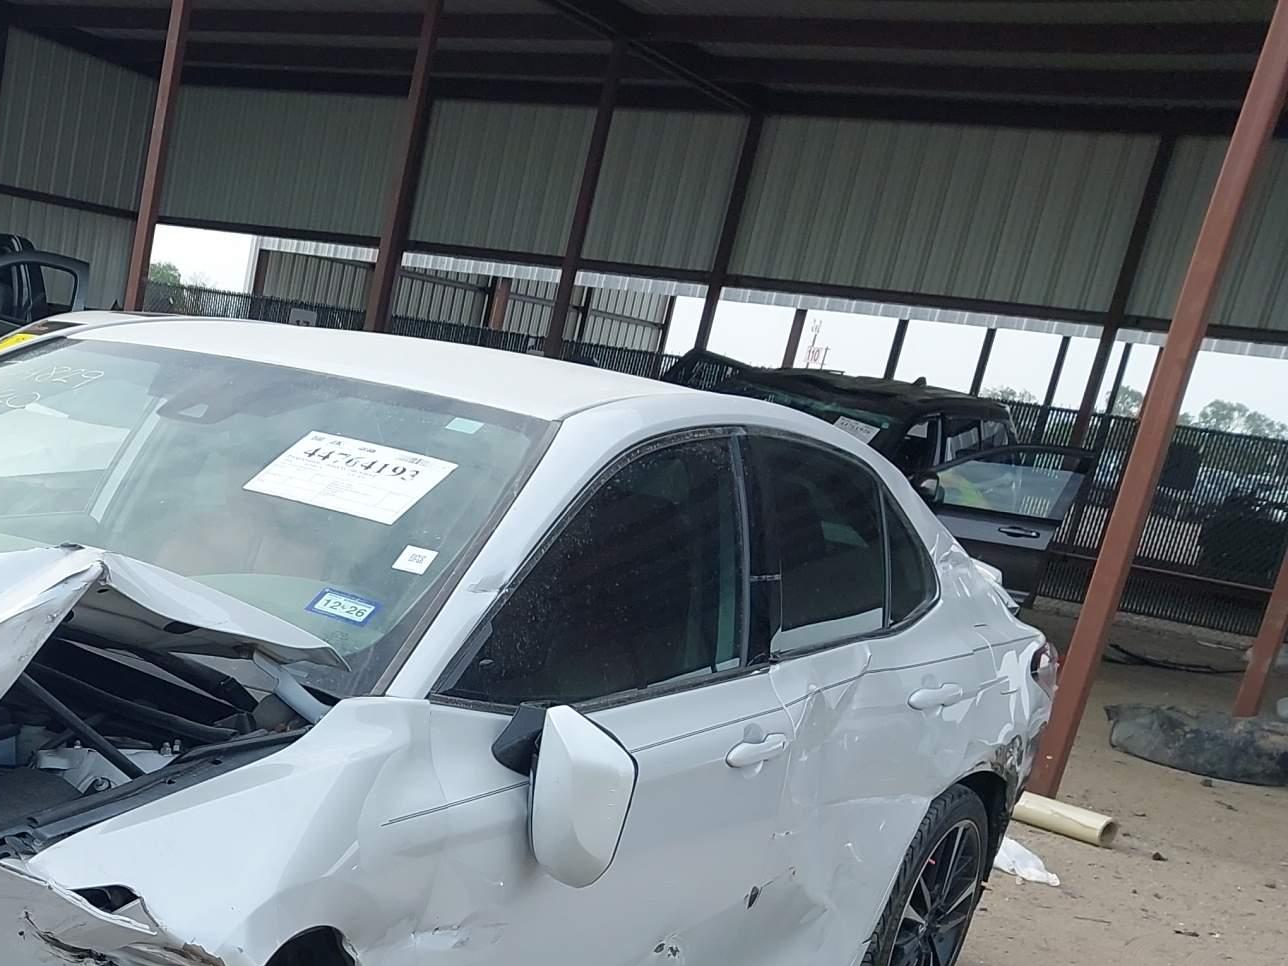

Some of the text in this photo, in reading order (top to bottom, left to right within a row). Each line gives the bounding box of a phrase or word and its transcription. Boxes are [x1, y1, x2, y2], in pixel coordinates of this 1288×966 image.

[303, 446, 420, 481] 44764193
[323, 598, 368, 618] 12 26
